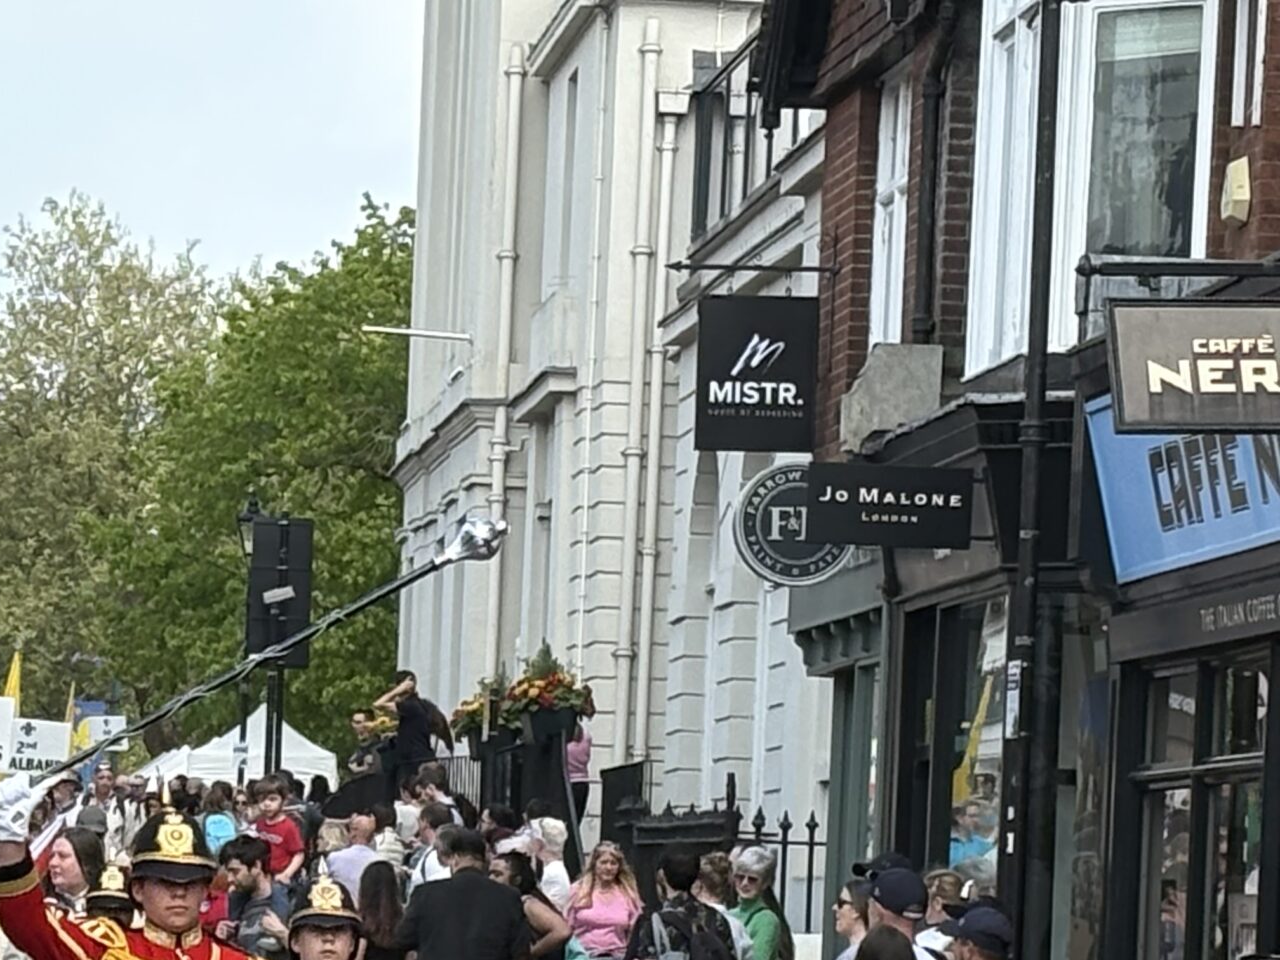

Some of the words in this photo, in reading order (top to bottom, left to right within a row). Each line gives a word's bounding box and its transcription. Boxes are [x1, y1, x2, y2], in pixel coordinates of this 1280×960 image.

[708, 380, 804, 405] MISTR.
[747, 471, 802, 515] FARROW
[859, 487, 962, 508] MALONE
